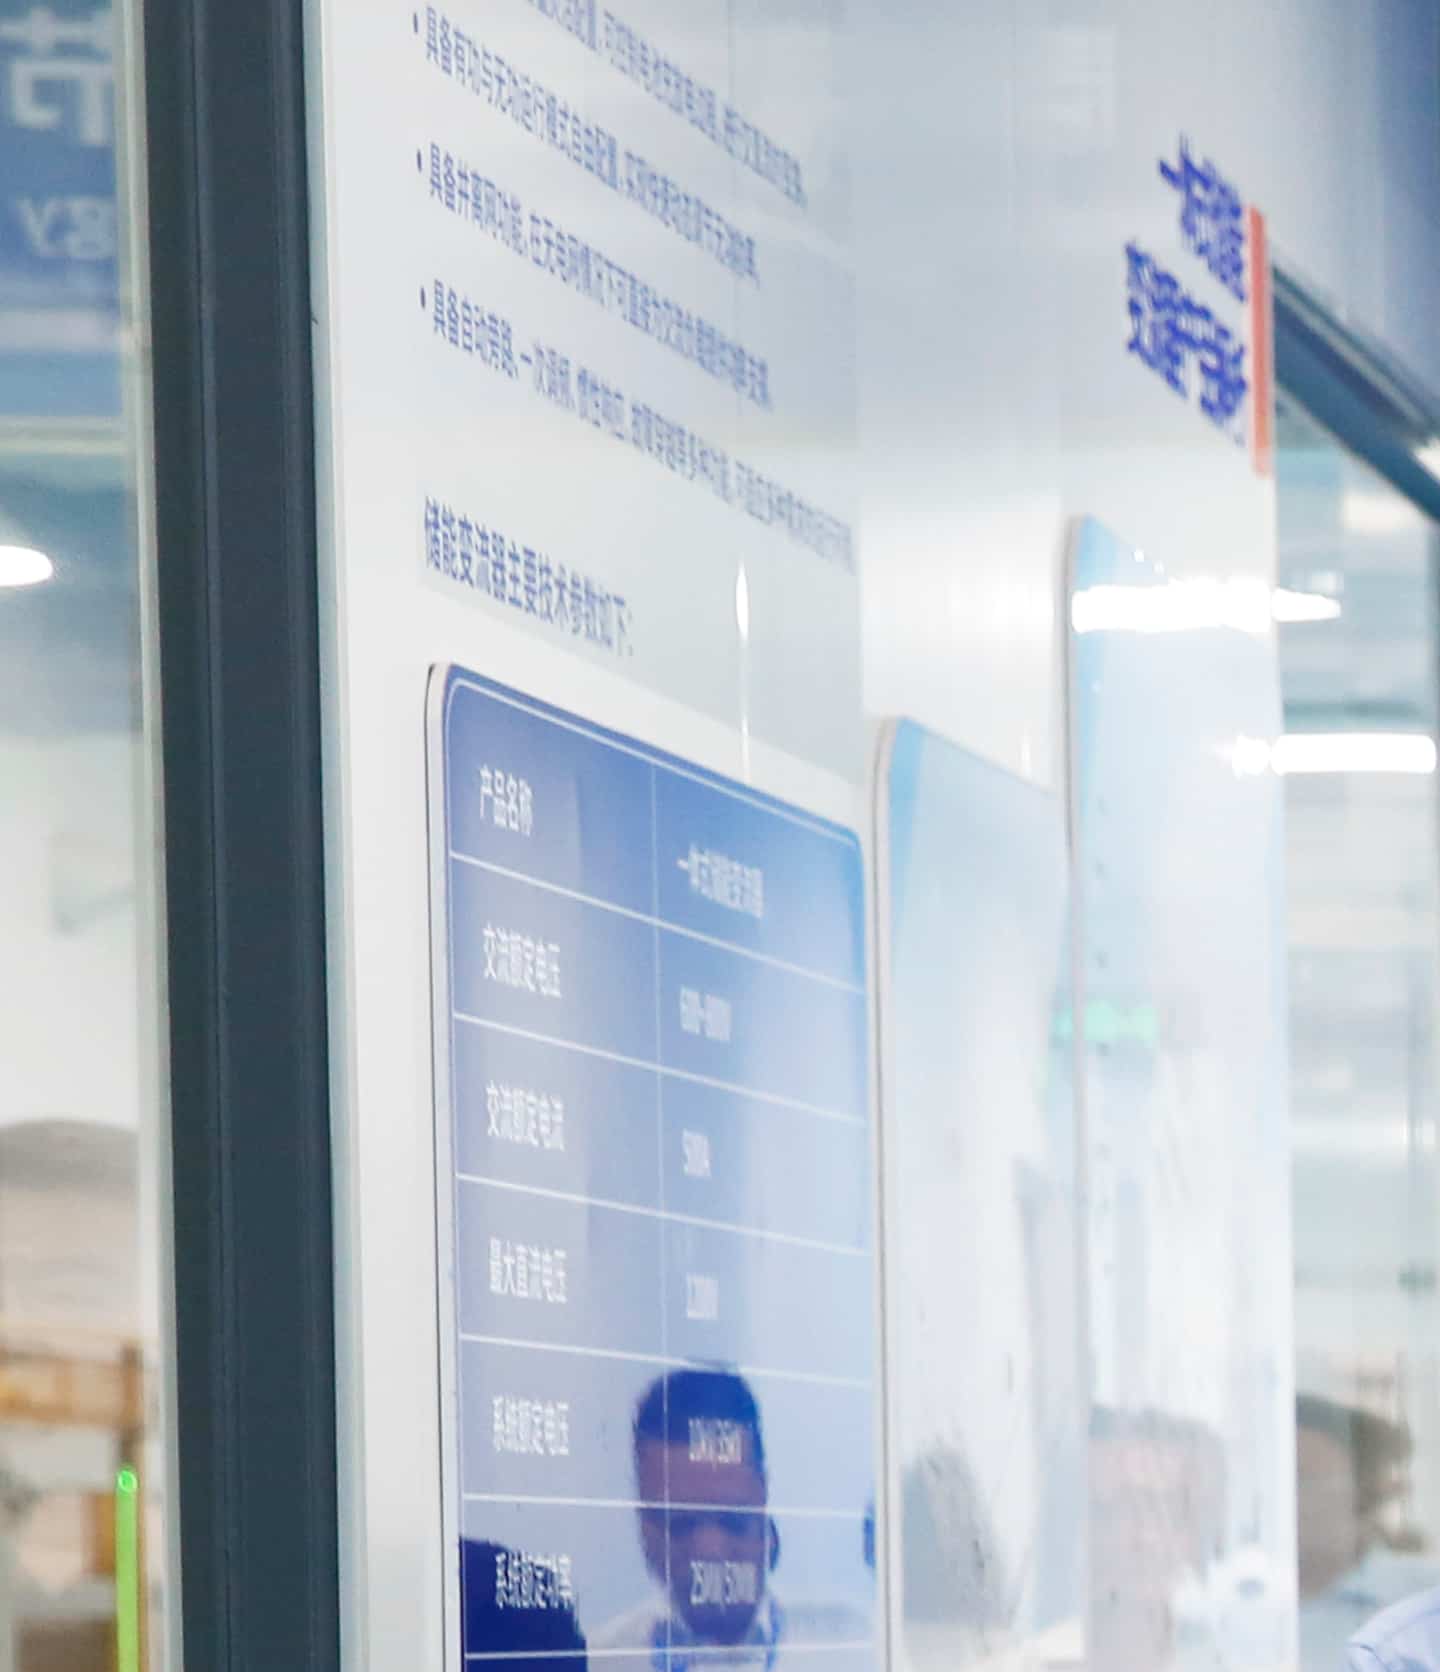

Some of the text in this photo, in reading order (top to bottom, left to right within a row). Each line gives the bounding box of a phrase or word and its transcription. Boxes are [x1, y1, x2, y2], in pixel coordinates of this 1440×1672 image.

[478, 763, 534, 839] 产品名称
[482, 923, 562, 1000] 交流额定电压
